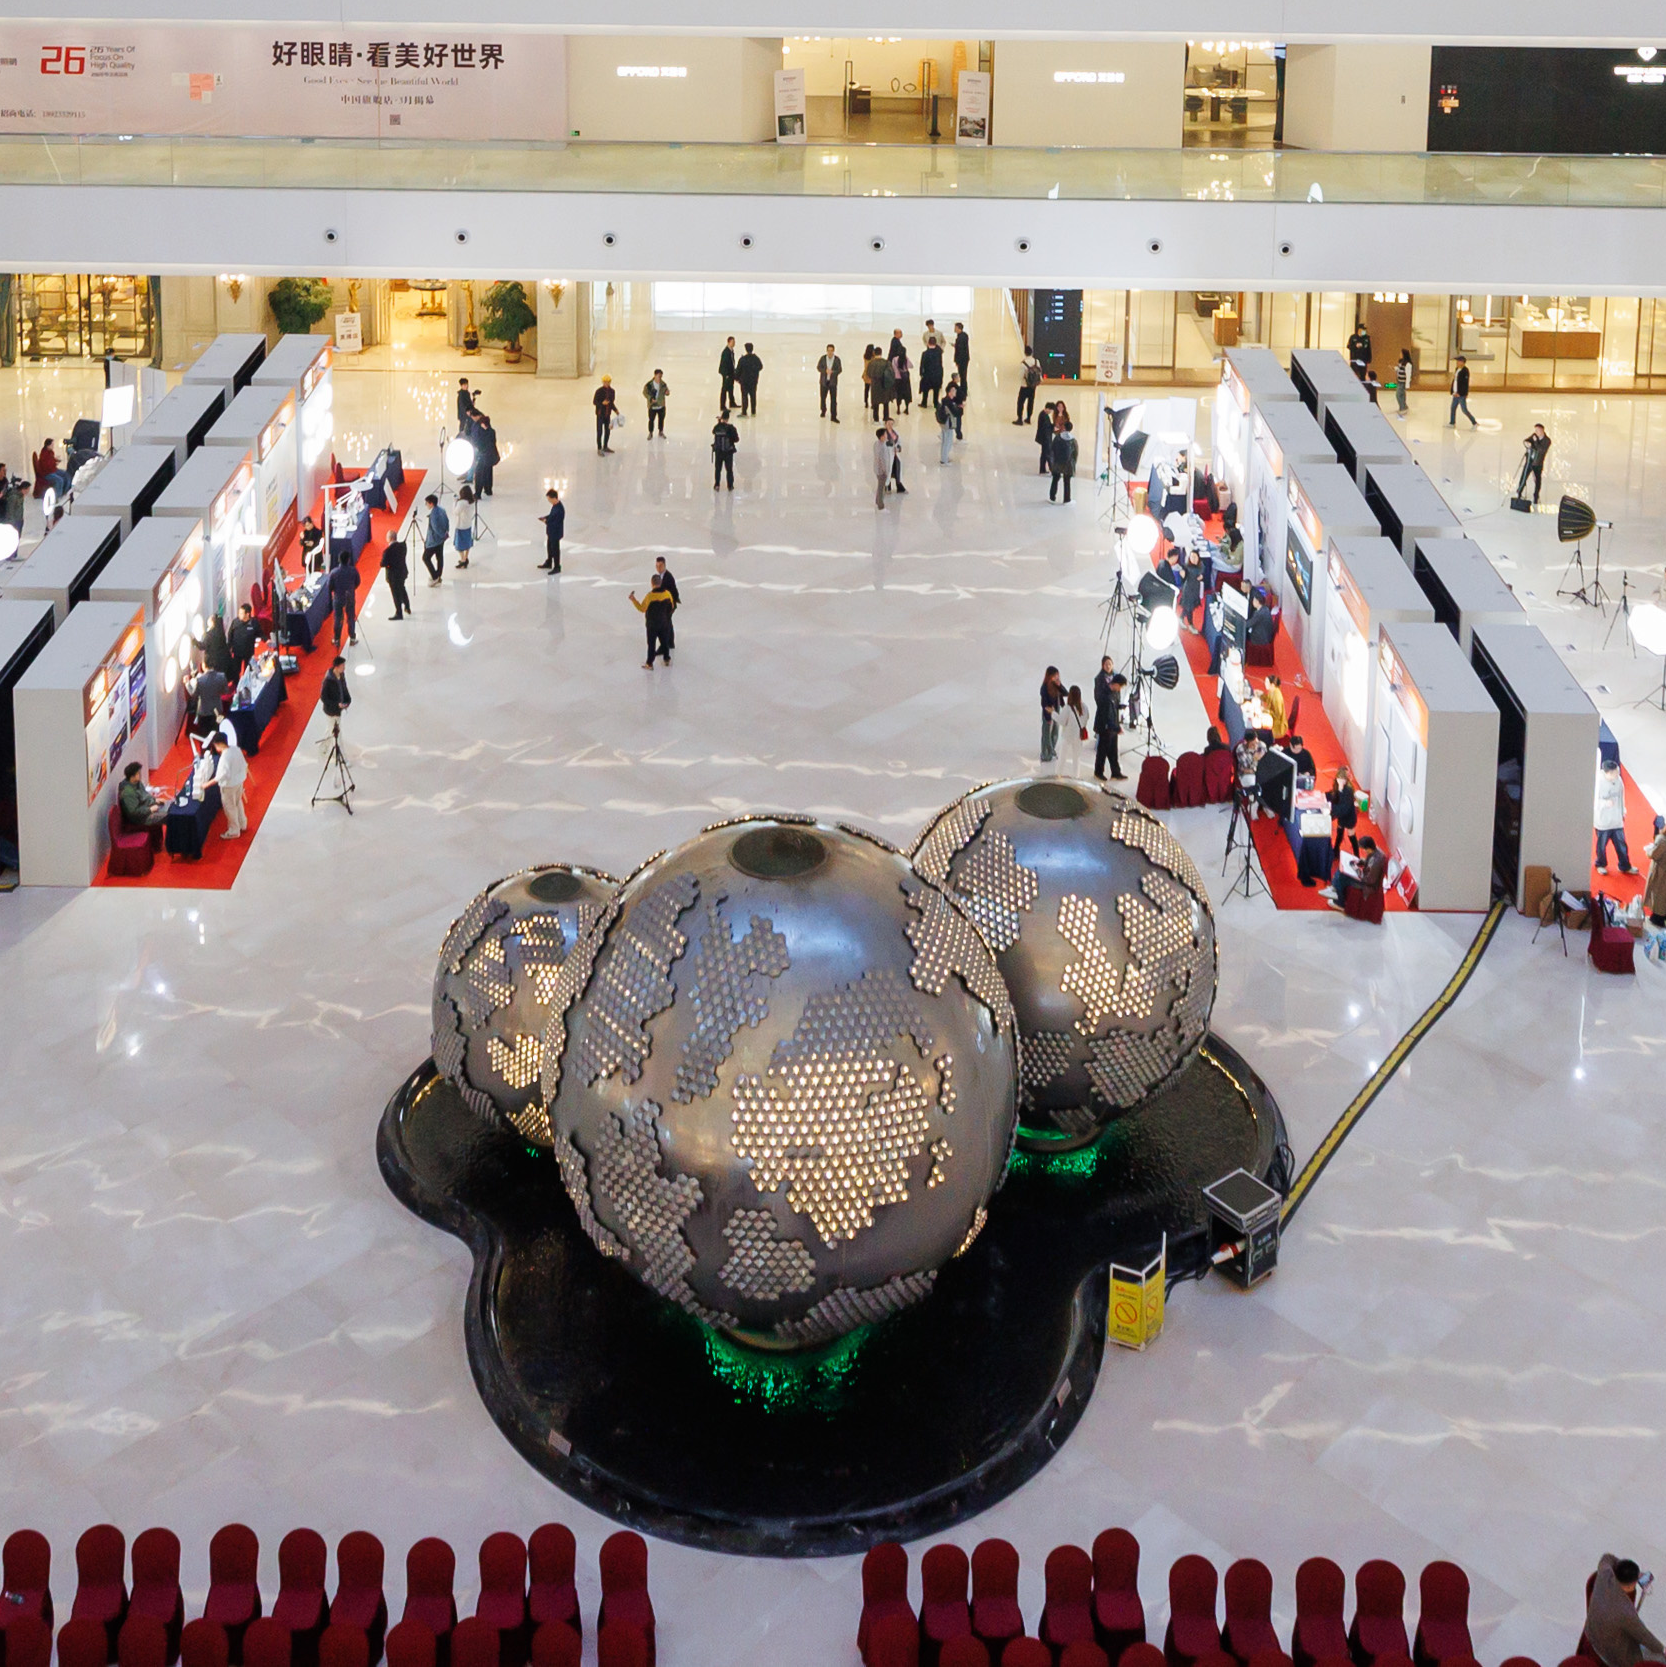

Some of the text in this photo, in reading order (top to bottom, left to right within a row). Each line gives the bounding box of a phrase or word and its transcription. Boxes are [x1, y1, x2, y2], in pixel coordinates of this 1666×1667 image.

[41, 46, 85, 74] 26
[272, 40, 505, 70] 好眼睛·看美好世界
